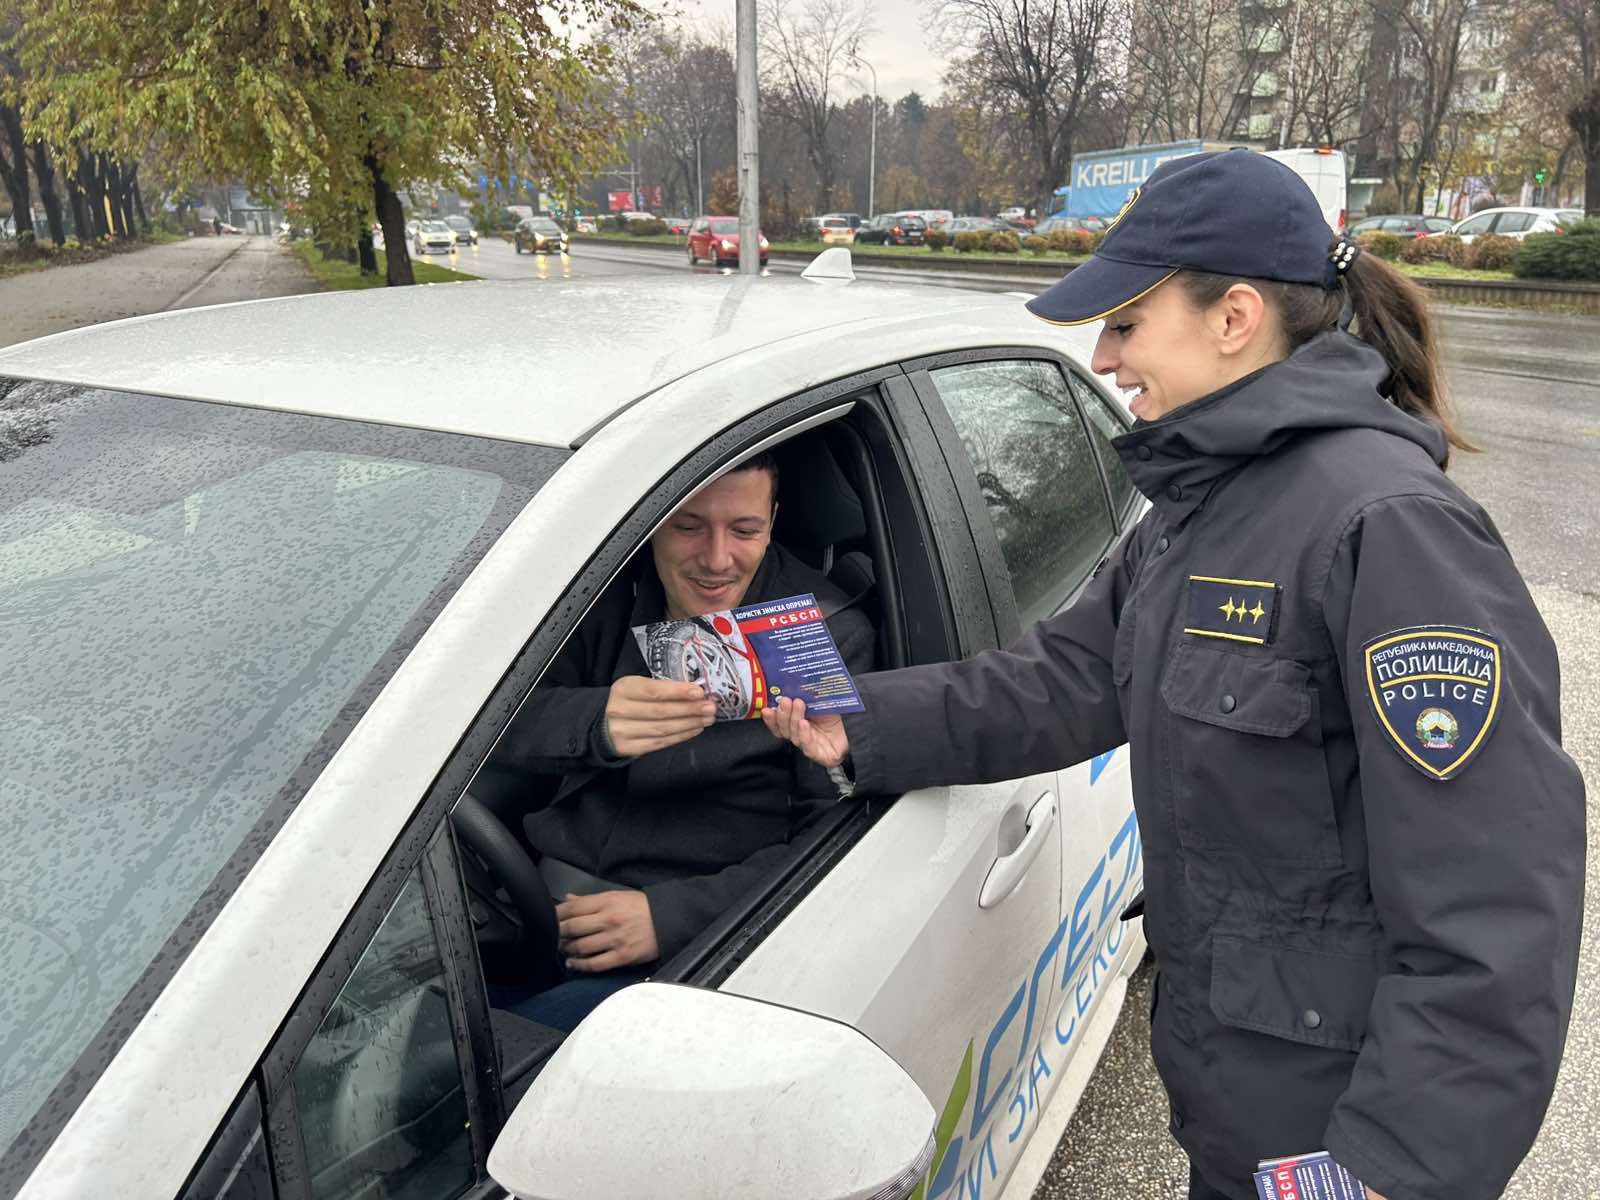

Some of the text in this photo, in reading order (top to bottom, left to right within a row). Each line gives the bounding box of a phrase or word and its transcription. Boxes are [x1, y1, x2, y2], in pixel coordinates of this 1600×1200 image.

[1077, 156, 1171, 189] KREILL
[762, 605, 786, 615] ЗИМСКА
[769, 609, 819, 626] РСБСП
[1371, 641, 1495, 664] РЕПУБЛИКА МАКЕДОНИЈА
[1376, 654, 1491, 681] ПОЛИЦИЈА
[1383, 682, 1488, 707] POLICE
[1008, 1040, 1052, 1144] ЗА
